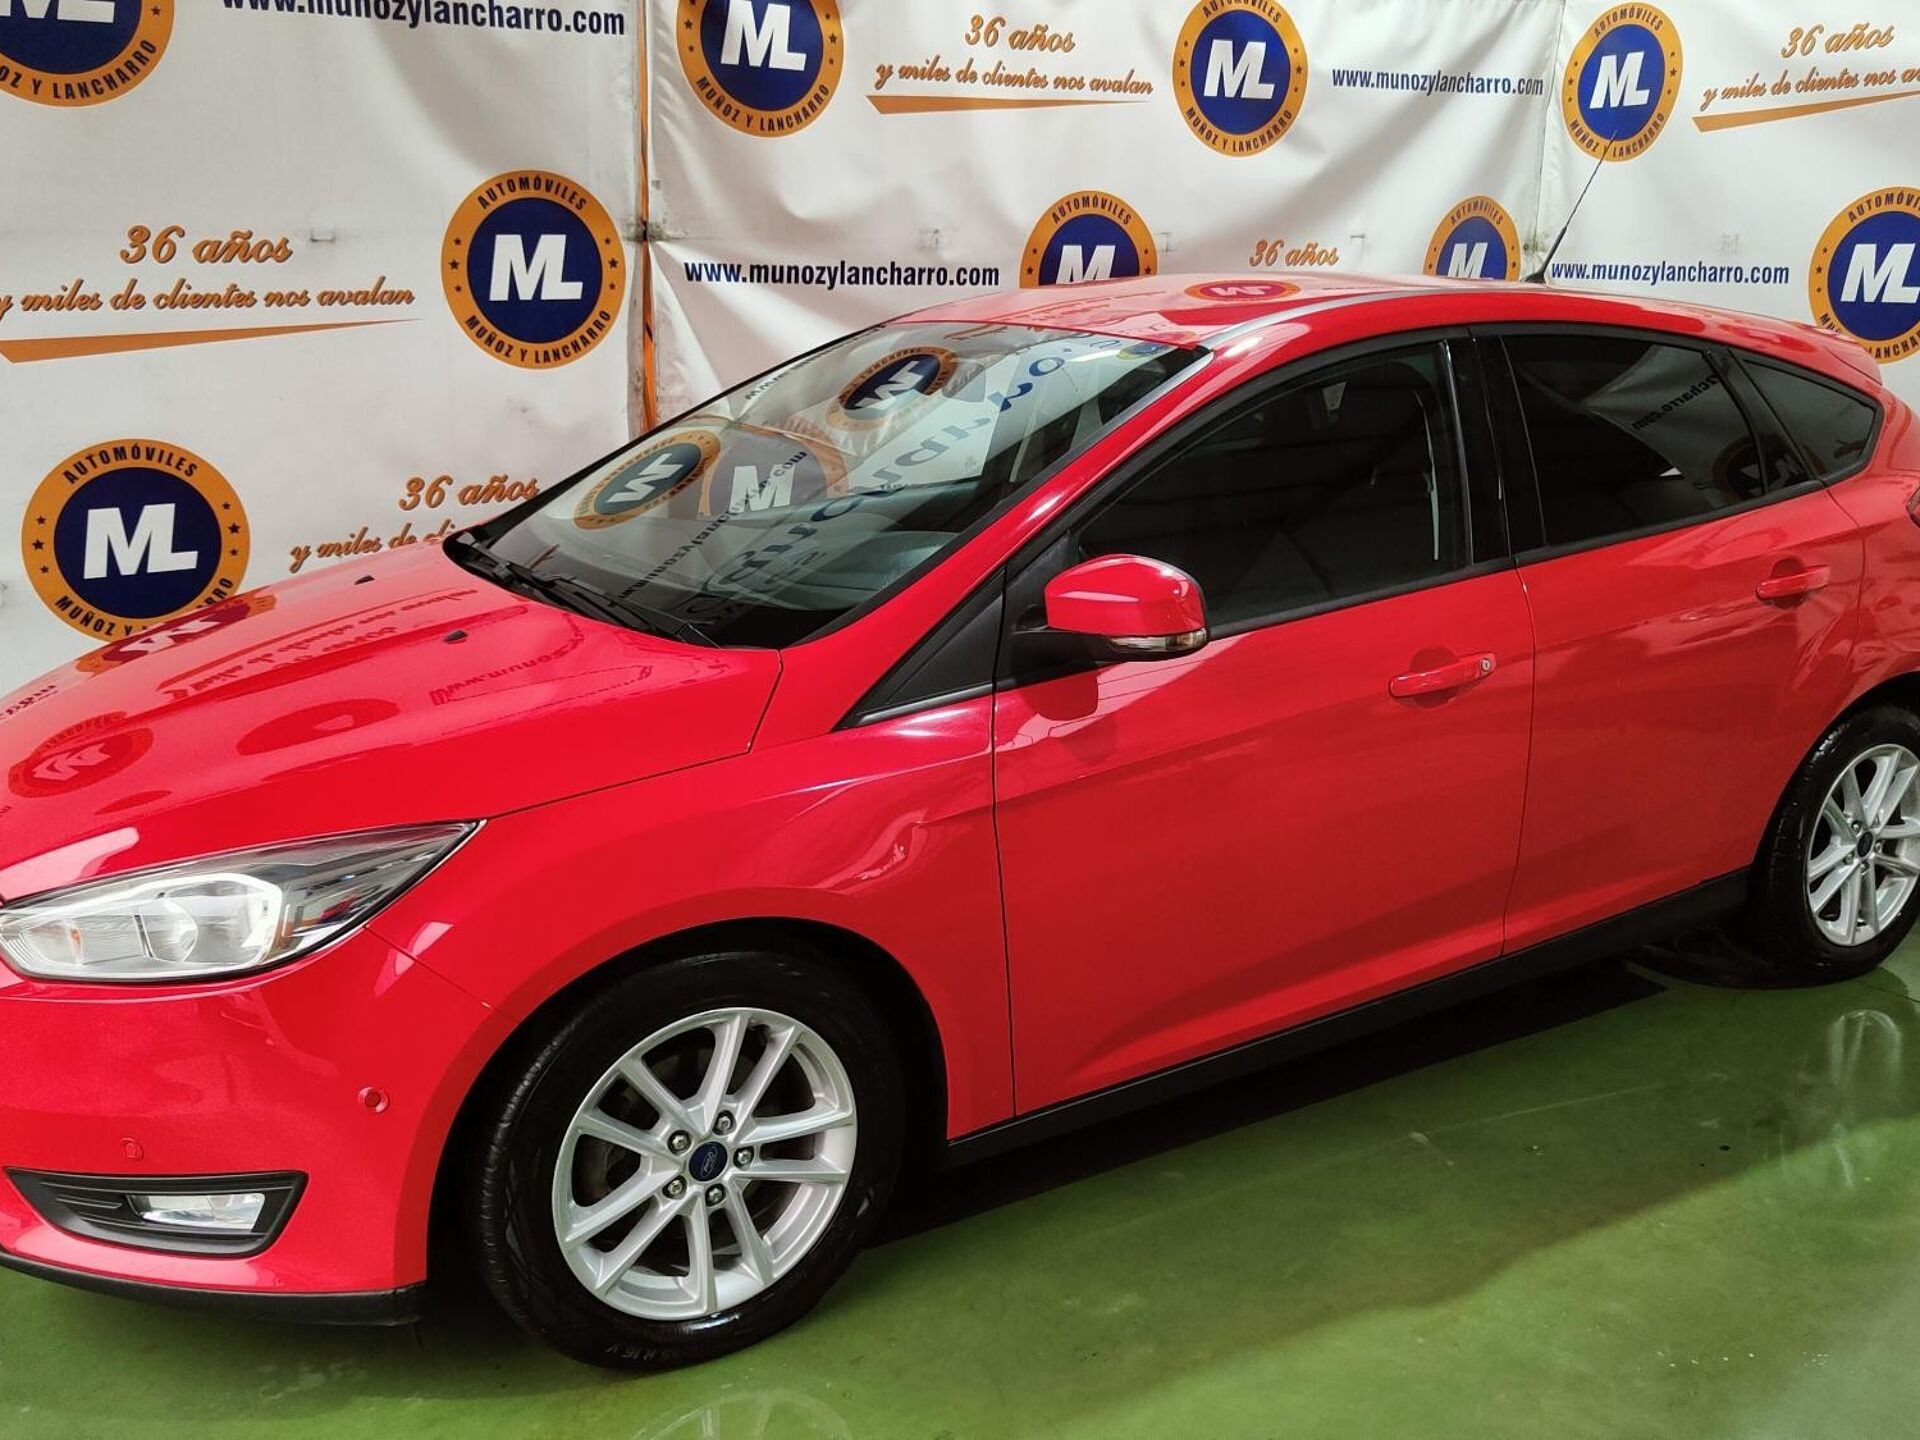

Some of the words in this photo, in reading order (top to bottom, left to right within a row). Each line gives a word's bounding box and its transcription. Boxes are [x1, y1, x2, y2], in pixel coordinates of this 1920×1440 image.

[720, 0, 807, 71] ML
[965, 14, 1006, 47] 36
[1008, 24, 1076, 53] años
[1781, 23, 1825, 59] 36
[1825, 22, 1895, 54] años
[53, 39, 157, 99] LANCHARRO
[874, 62, 893, 90] y
[899, 54, 951, 82] miles
[956, 58, 978, 83] de
[981, 60, 1049, 89] clientes
[1053, 74, 1085, 90] nos
[1089, 68, 1153, 95] avalan
[1203, 39, 1275, 100] ML
[1332, 69, 1544, 96] www.munozylancharro.com
[1589, 51, 1650, 109] ML
[1700, 87, 1718, 112] y
[1721, 73, 1767, 100] miles
[1771, 69, 1791, 96] de
[1795, 66, 1860, 93] clientes
[1864, 69, 1897, 87] nos
[696, 76, 741, 123] MUÑOZ
[746, 114, 754, 128] Y
[760, 84, 830, 132] LANCHARRO
[1233, 110, 1293, 153] LANCHARRO
[477, 175, 587, 211] AUTOMÓVILES
[1052, 193, 1132, 226] AUTOMÓVILES
[120, 224, 186, 264] 36
[192, 229, 293, 264] años
[1249, 239, 1284, 267] 36
[1285, 242, 1339, 267] años
[489, 233, 583, 301] ML
[684, 260, 1000, 290] www.munozylancharro.com
[1551, 260, 1790, 286] www.munozylancharro.com
[1840, 243, 1920, 303] ML
[21, 278, 101, 311] miles
[110, 278, 146, 310] de
[153, 277, 257, 310] clientes
[264, 287, 310, 307] nos
[316, 275, 416, 305] avalan
[465, 315, 514, 358] MUÑOZ
[520, 348, 529, 362] Y
[535, 310, 612, 364] LANCHARRO
[62, 443, 197, 484] AUTOMÓVILES
[399, 474, 453, 511] 36
[458, 474, 540, 505] años
[83, 503, 199, 580] ML
[289, 542, 312, 574] y
[317, 526, 382, 558] miles
[54, 594, 116, 637] MUÑOZ
